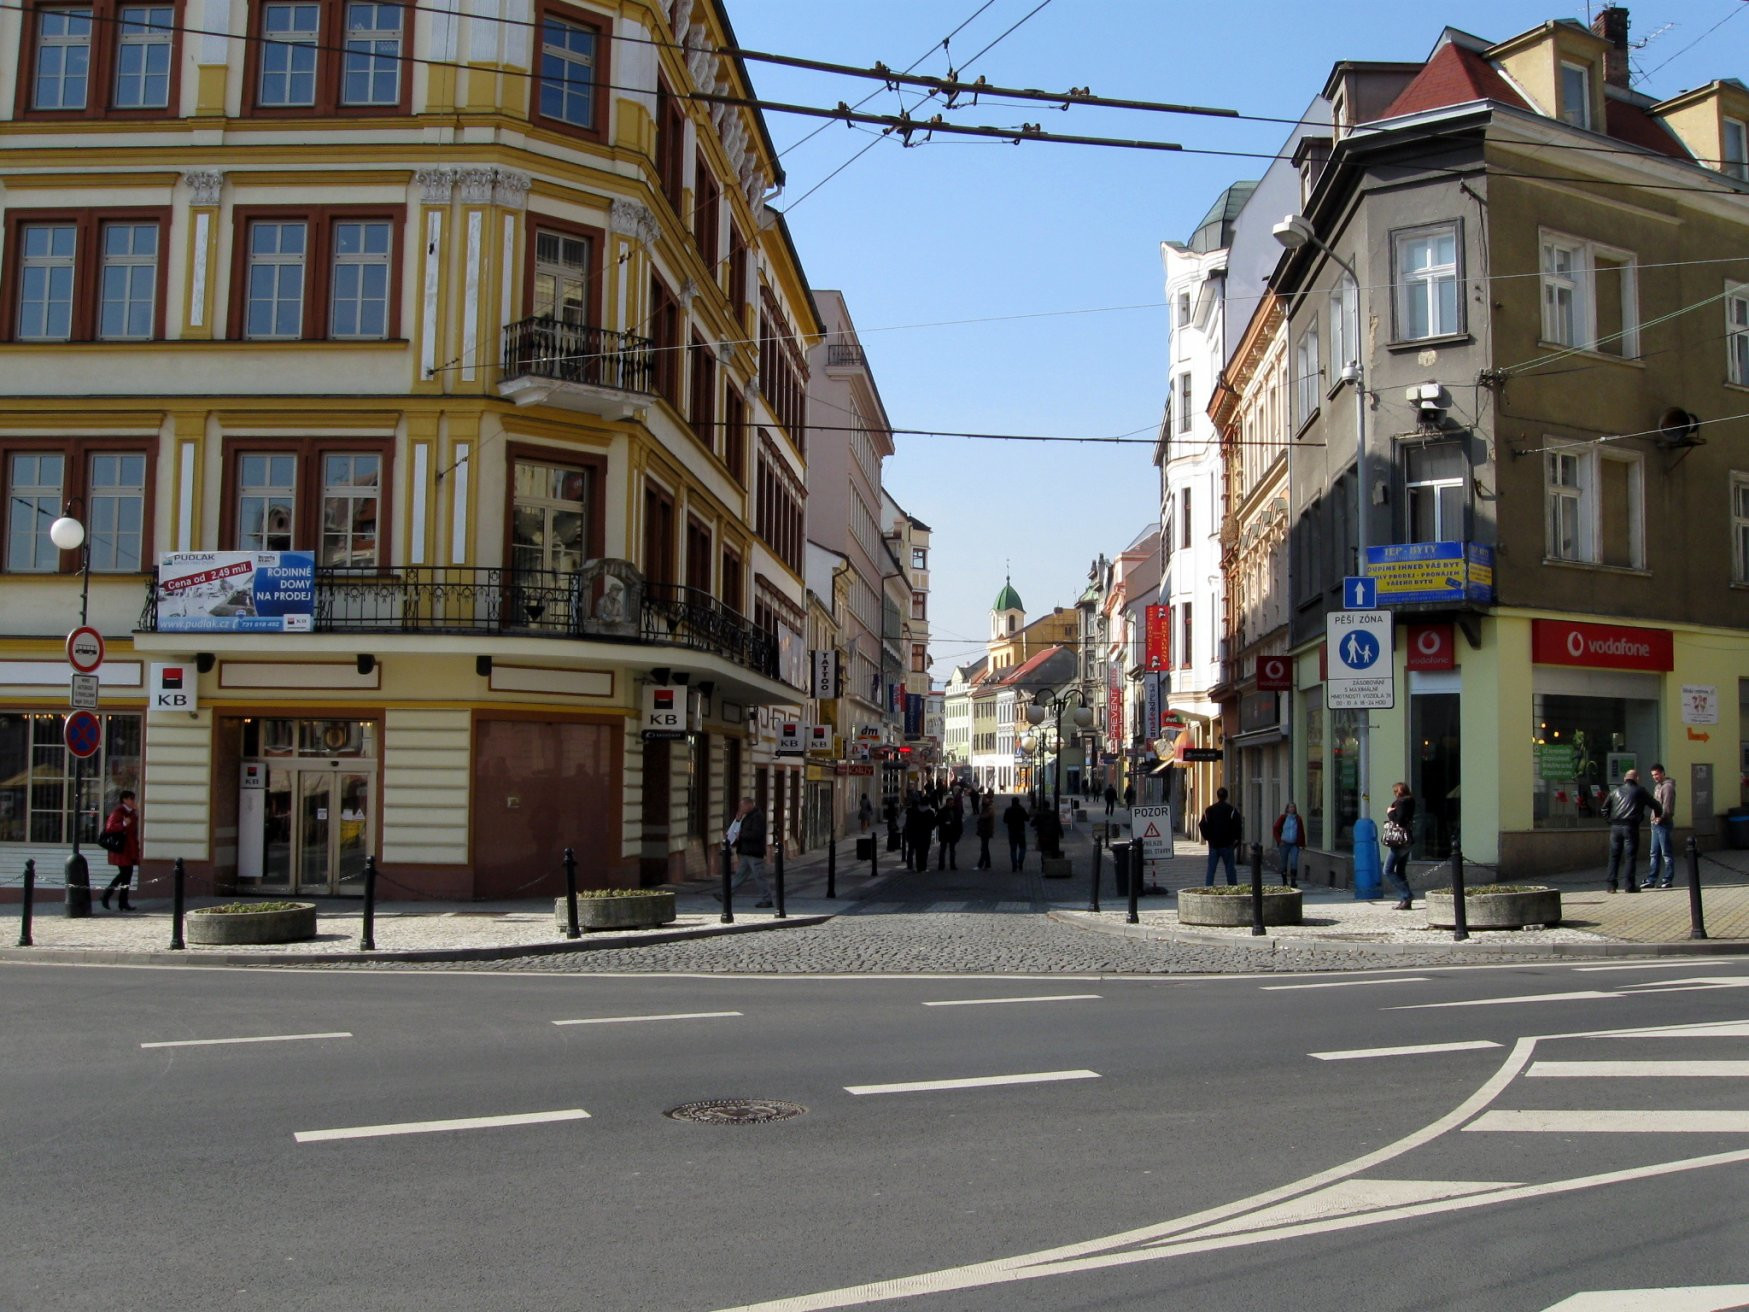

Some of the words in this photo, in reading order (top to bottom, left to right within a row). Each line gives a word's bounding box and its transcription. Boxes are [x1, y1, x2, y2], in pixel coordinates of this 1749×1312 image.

[1409, 544, 1437, 554] BYTY
[168, 579, 192, 590] Cena
[194, 574, 206, 583] od
[211, 568, 230, 580] 2,49
[232, 563, 250, 575] mil.
[267, 566, 312, 577] RODINNÉ
[280, 580, 311, 589] DOMY
[256, 592, 271, 601] NA
[274, 591, 311, 601] PRODEJ
[1335, 614, 1354, 624] PĚŠÍ
[1359, 614, 1383, 624] ZÓNA
[1588, 637, 1650, 656] vodafone
[1410, 656, 1449, 664] vodafone
[821, 653, 829, 691] TATTOO
[158, 694, 187, 706] KB
[650, 714, 678, 725] KB
[1110, 689, 1118, 739] PREVENT
[861, 725, 878, 736] dm
[1134, 806, 1168, 818] POZOR
